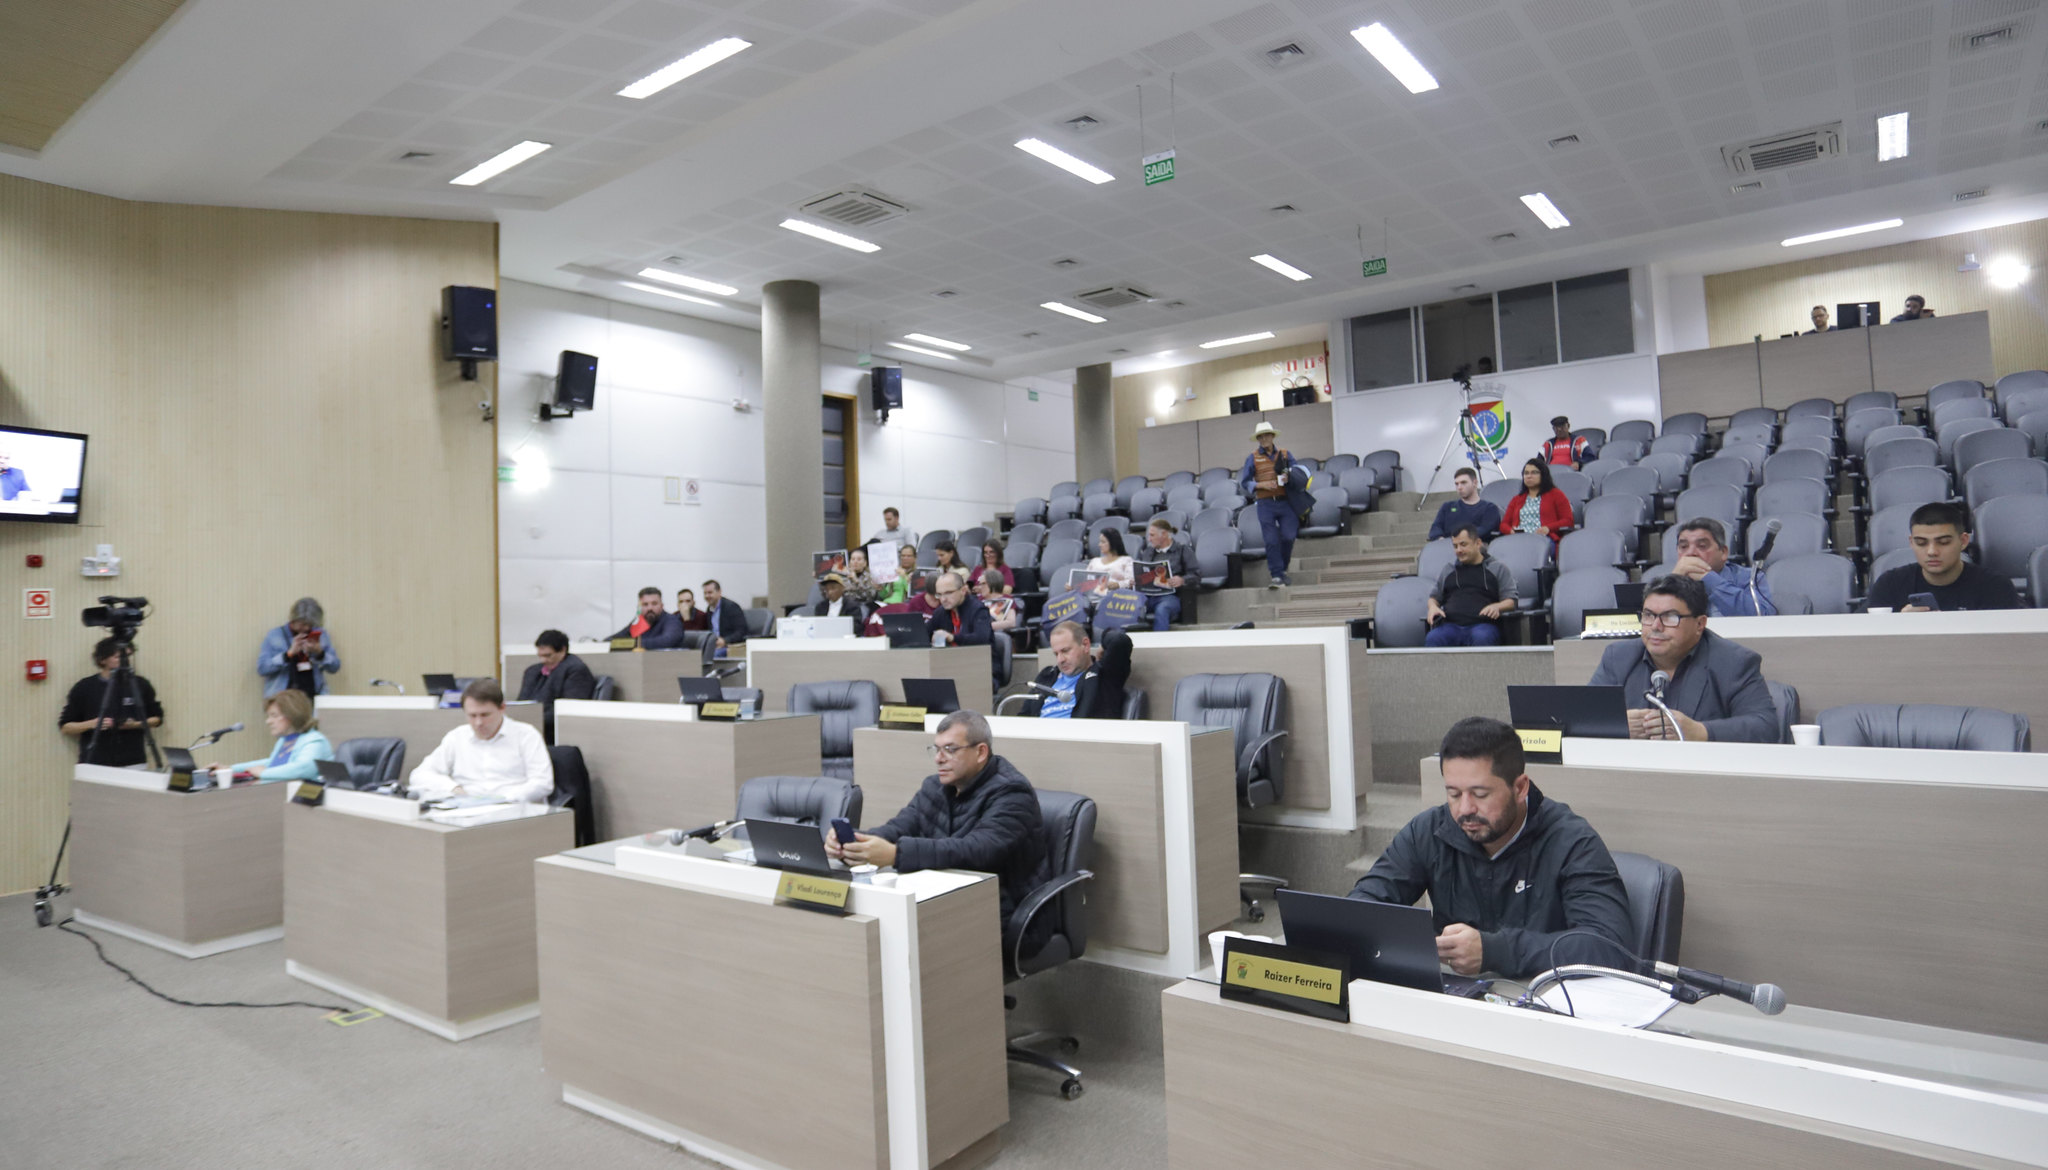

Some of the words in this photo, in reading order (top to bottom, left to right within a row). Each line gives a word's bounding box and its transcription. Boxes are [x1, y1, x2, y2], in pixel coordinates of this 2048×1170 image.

[1522, 737, 1547, 745] rizola
[778, 850, 801, 861] VAIO
[797, 883, 812, 893] Vladi
[813, 885, 842, 898] Lourenço
[1264, 969, 1293, 983] Raizer
[1295, 974, 1333, 990] Ferreira
